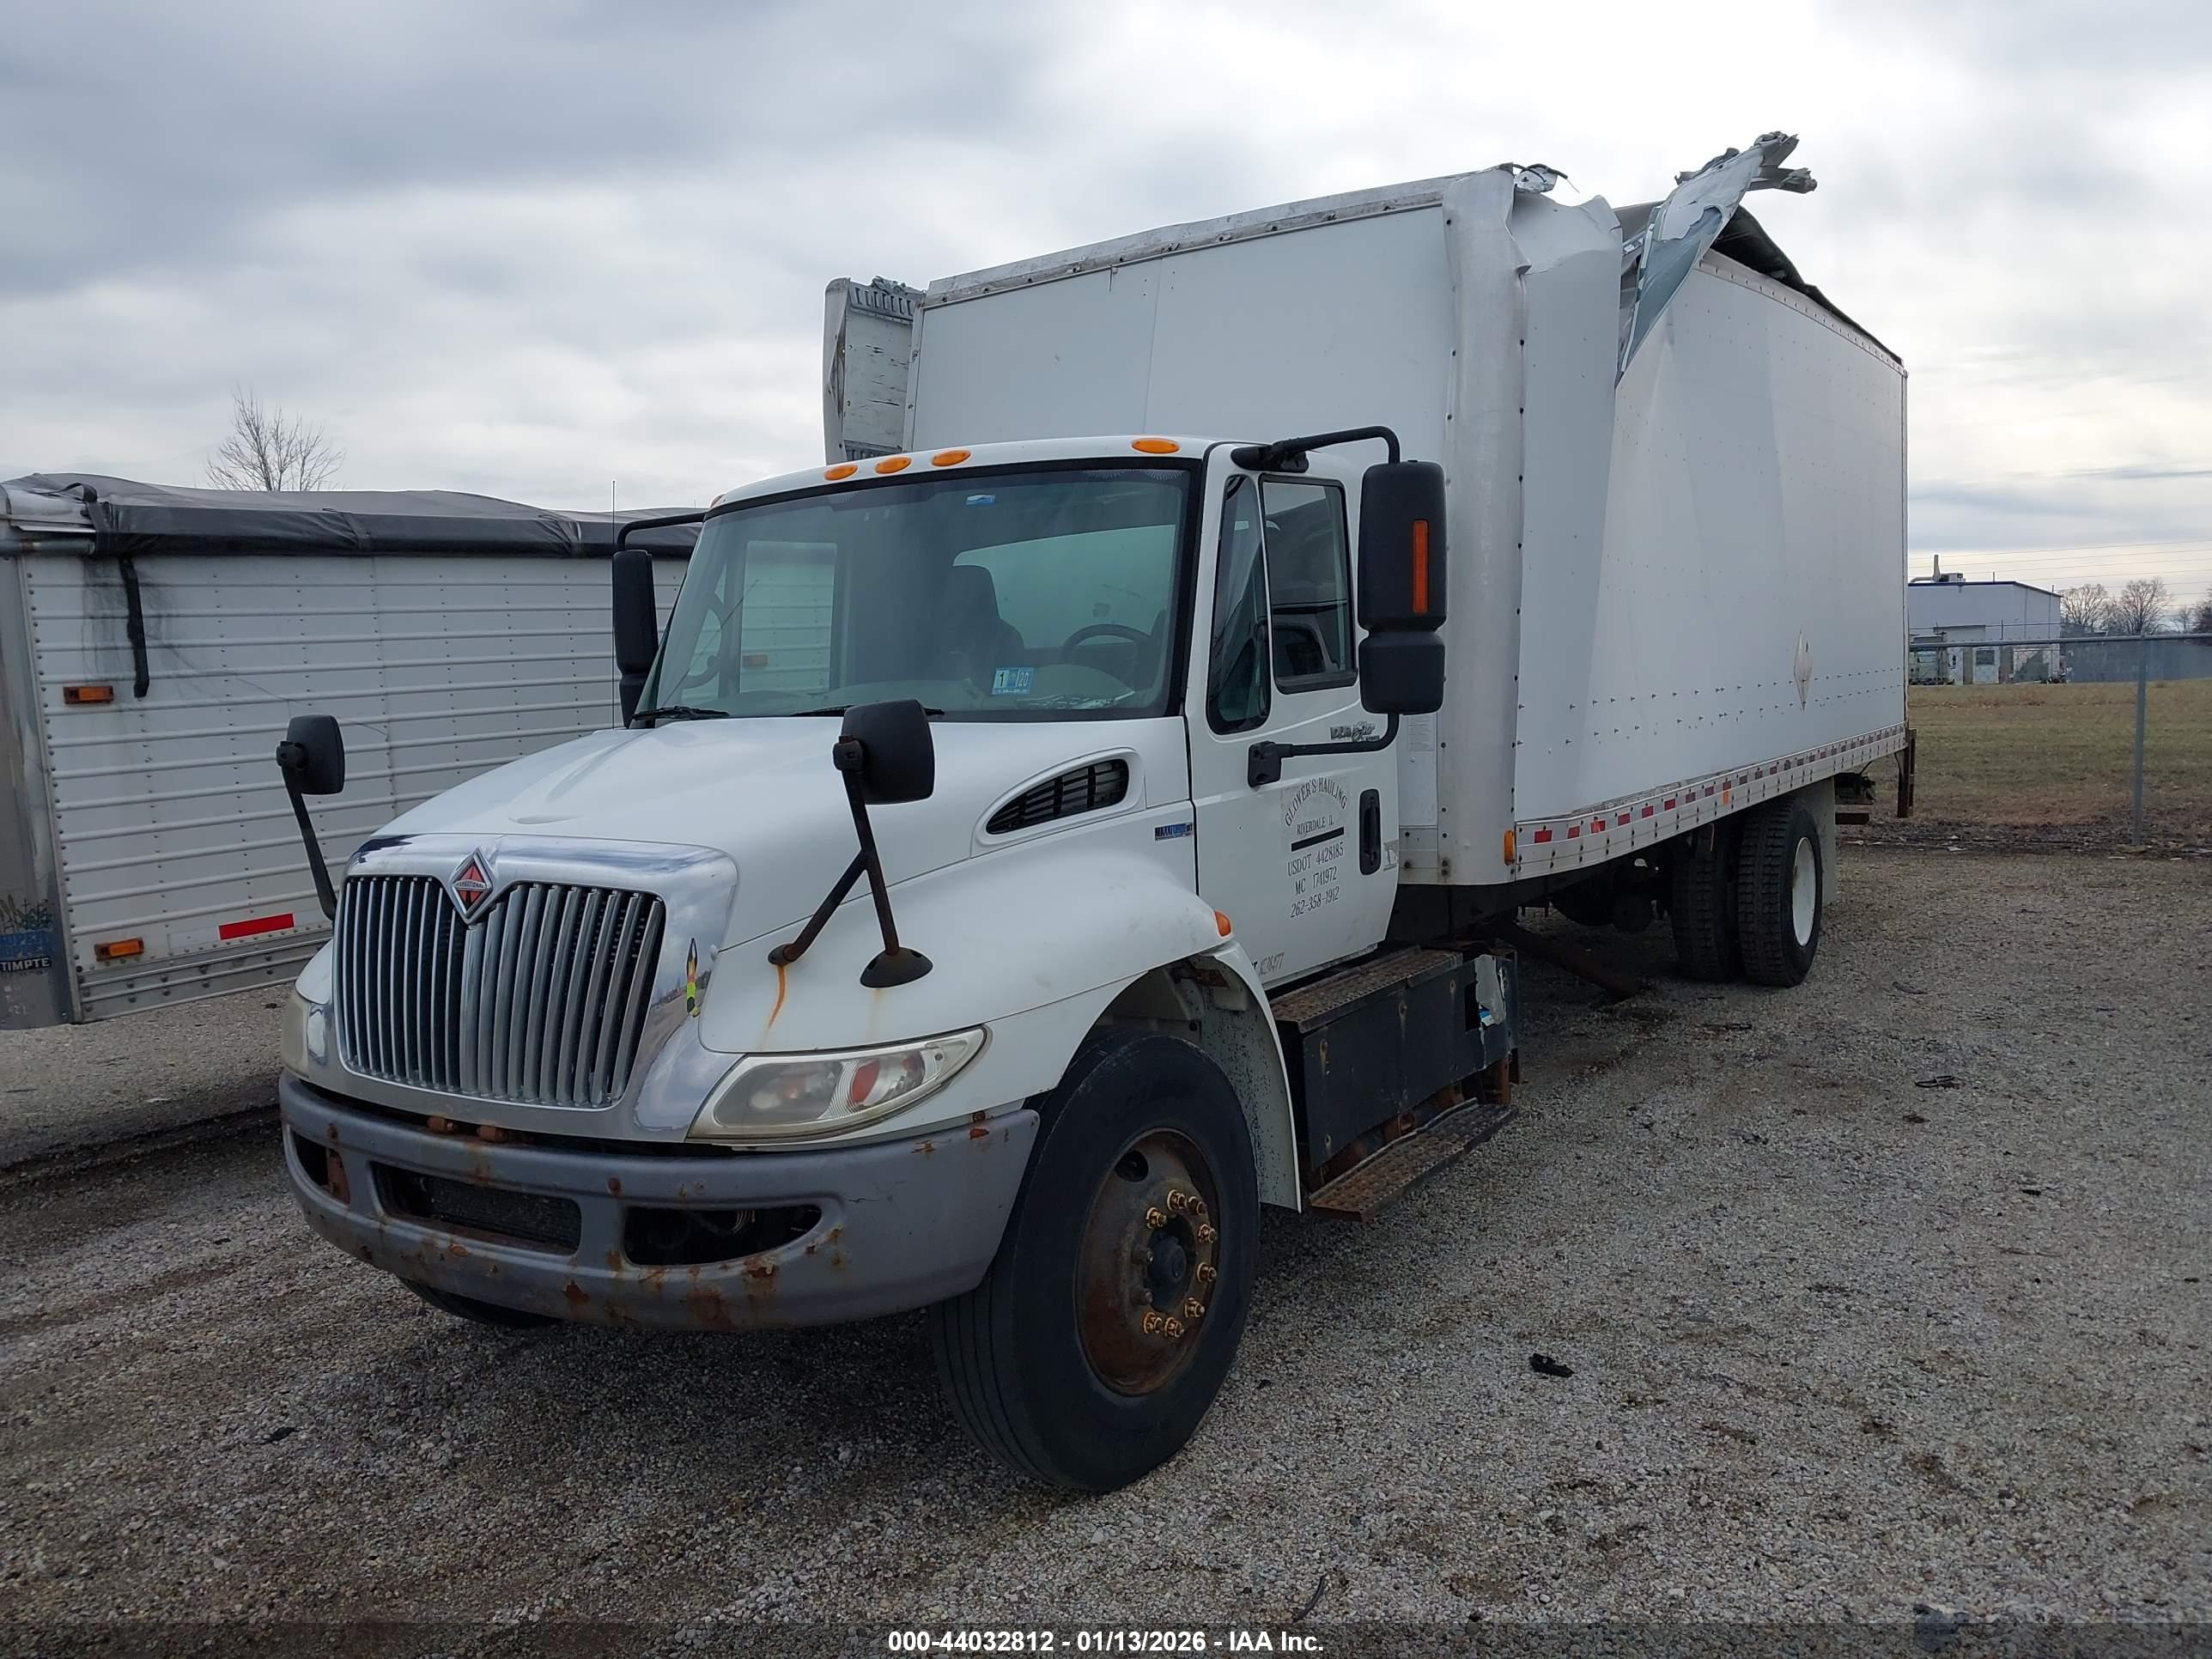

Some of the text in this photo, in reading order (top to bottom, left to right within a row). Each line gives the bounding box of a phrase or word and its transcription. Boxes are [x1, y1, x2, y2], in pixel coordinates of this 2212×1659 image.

[1285, 777, 1347, 826] GLOVER'S HAULING
[1297, 817, 1326, 836] RIVERDALE
[1287, 842, 1344, 877] USDOT 4428185
[1295, 878, 1306, 896] MC
[1290, 885, 1340, 919] 262-358-1912
[0, 957, 50, 971] TIMPTE
